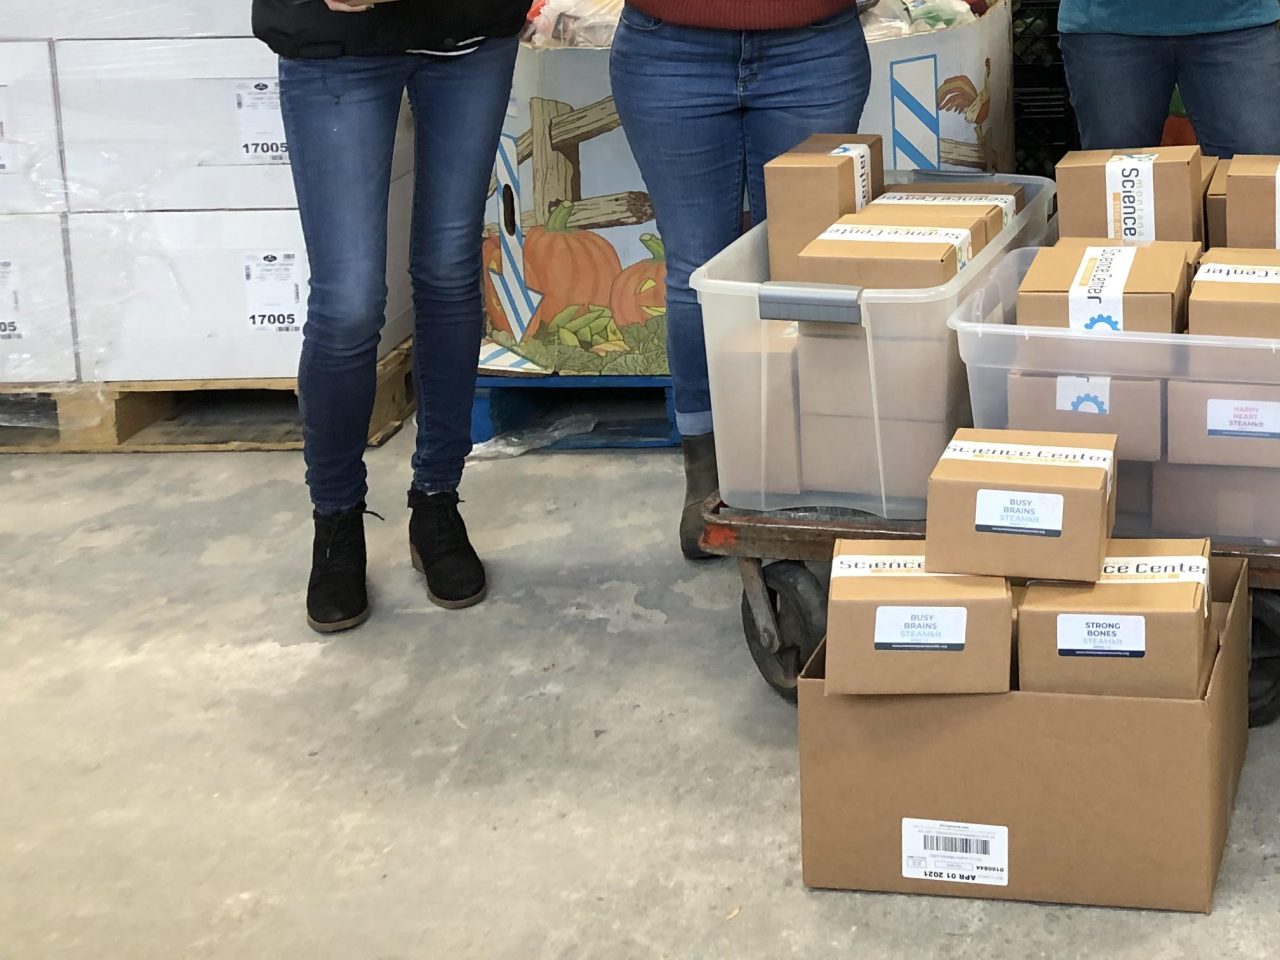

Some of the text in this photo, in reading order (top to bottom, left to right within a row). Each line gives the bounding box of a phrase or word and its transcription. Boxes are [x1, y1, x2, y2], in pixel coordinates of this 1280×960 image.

[242, 142, 288, 154] 17005
[1121, 168, 1139, 237] Science
[249, 314, 295, 325] 17005
[1010, 499, 1032, 507] BUSY
[1003, 506, 1035, 515] BRAINS
[904, 622, 937, 630] BRAINS
[1085, 622, 1120, 630] STRONG
[1087, 629, 1117, 637] BONES
